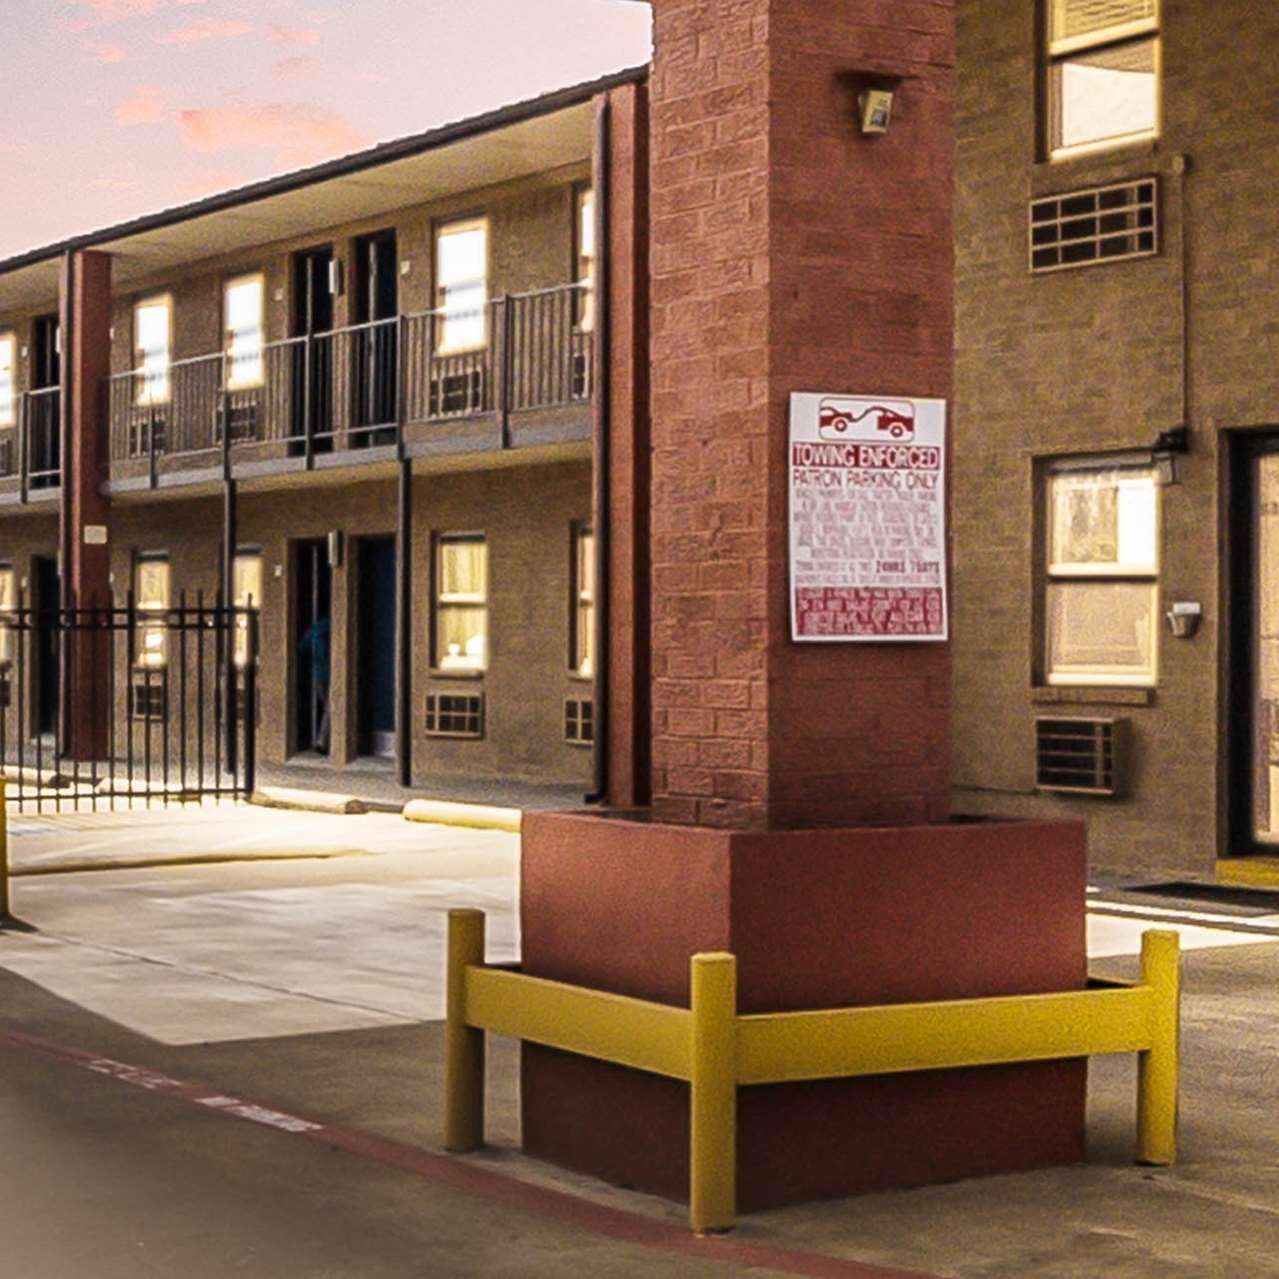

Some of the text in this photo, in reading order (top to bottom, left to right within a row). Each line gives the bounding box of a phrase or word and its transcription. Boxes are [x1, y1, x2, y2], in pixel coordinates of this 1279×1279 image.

[794, 444, 938, 468] TOWING ENFORCED
[793, 469, 938, 489] PATRON PARKING ONLY
